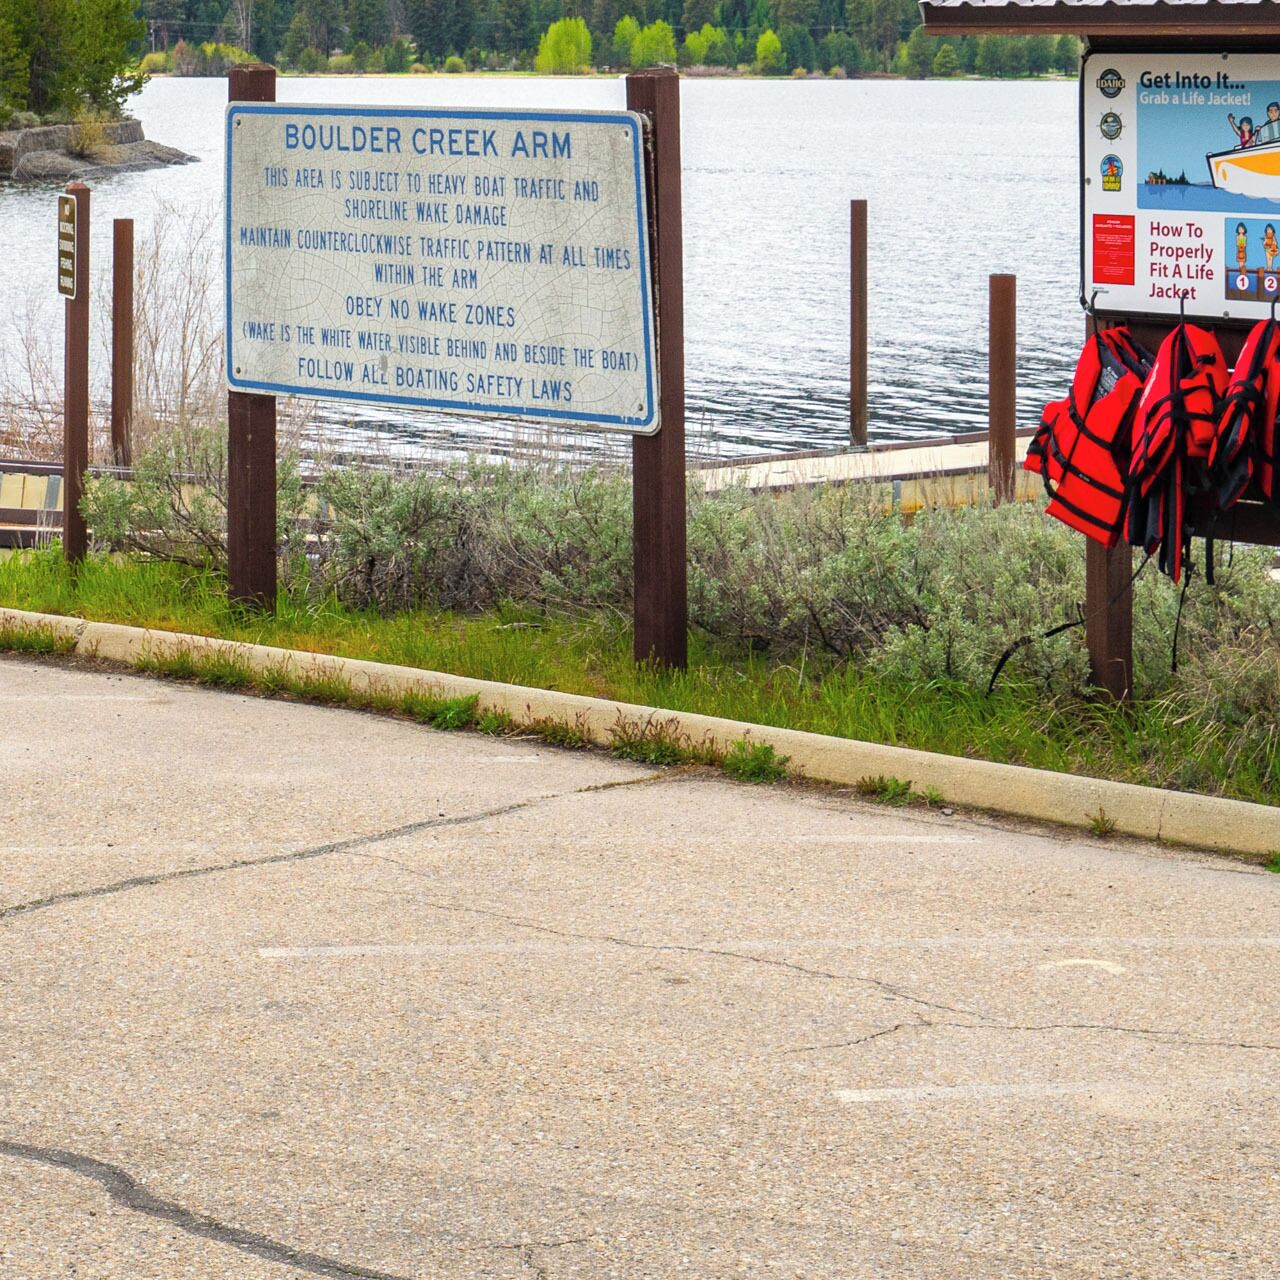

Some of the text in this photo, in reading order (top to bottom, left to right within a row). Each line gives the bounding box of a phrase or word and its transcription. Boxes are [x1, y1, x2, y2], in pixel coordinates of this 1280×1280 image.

[1097, 79, 1125, 88] IDAHO
[1140, 70, 1245, 90] Get Into It...
[1140, 91, 1251, 106] Grab a Life Jacket!
[286, 124, 572, 159] BOULDER CREEK ARM
[264, 167, 599, 202] THIS AREA IS SUBJECT TO HEAVY BOAT TRAFFIC AND
[345, 199, 507, 226] SHORELINE WAKE DAMAGE
[1150, 221, 1203, 238] How To
[240, 227, 631, 270] MAINTAIN COUNTERCLOCKWISE TRAFFIC PATTERN AT ALL TIMES
[1150, 242, 1213, 263] Properly
[374, 263, 478, 289] WITHIN THE ARM
[1150, 262, 1168, 278] Fit
[1172, 265, 1183, 279] A
[1186, 264, 1214, 280] Life
[1239, 277, 1245, 287] 1
[1267, 278, 1274, 288] 2
[346, 296, 515, 328] OBEY NO WAKE ZONES
[242, 321, 639, 372] (WAKE IS THE WHITE WATER VISIBLE BEHIND AND BESIDE THE BOAT)
[298, 357, 572, 401] FOLLOW ALL BOATING SAFETY LAWS
